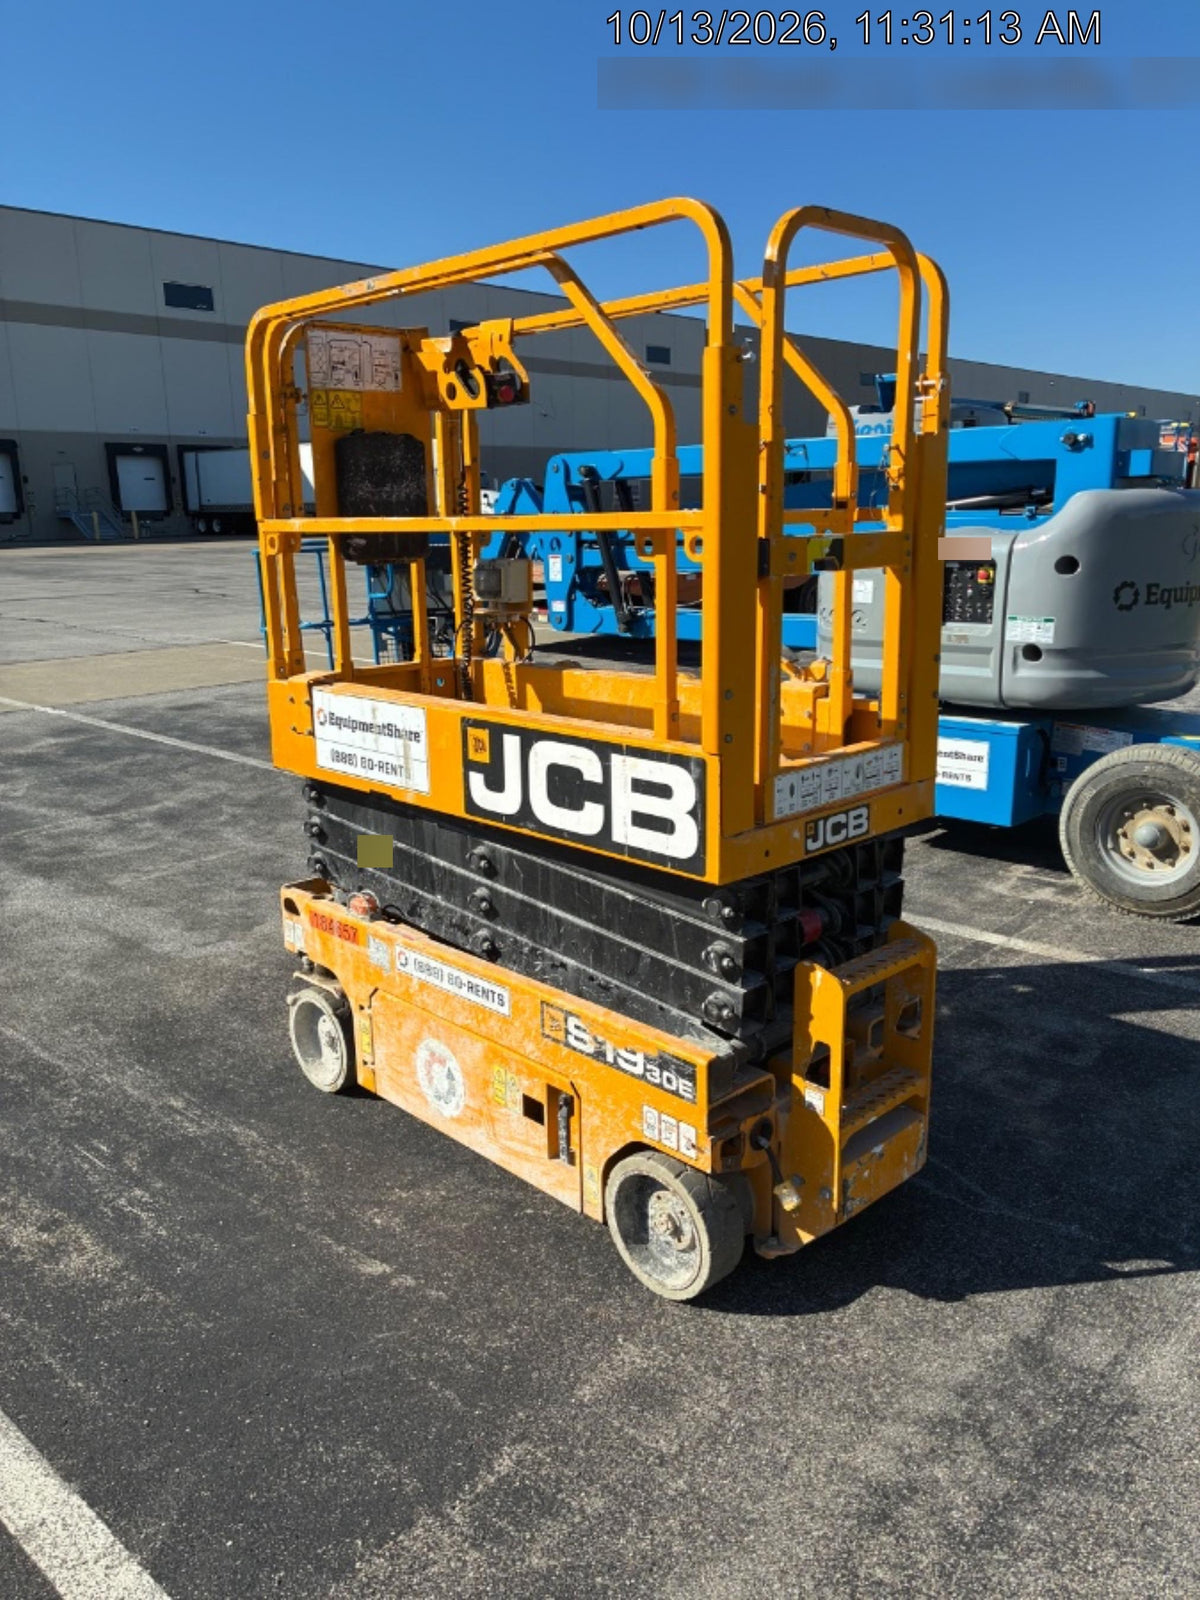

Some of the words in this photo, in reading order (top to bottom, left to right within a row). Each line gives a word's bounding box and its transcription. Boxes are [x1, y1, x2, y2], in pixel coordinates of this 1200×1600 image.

[1144, 581, 1200, 610] Equip
[467, 733, 699, 861] JCB
[806, 806, 869, 852] JCB
